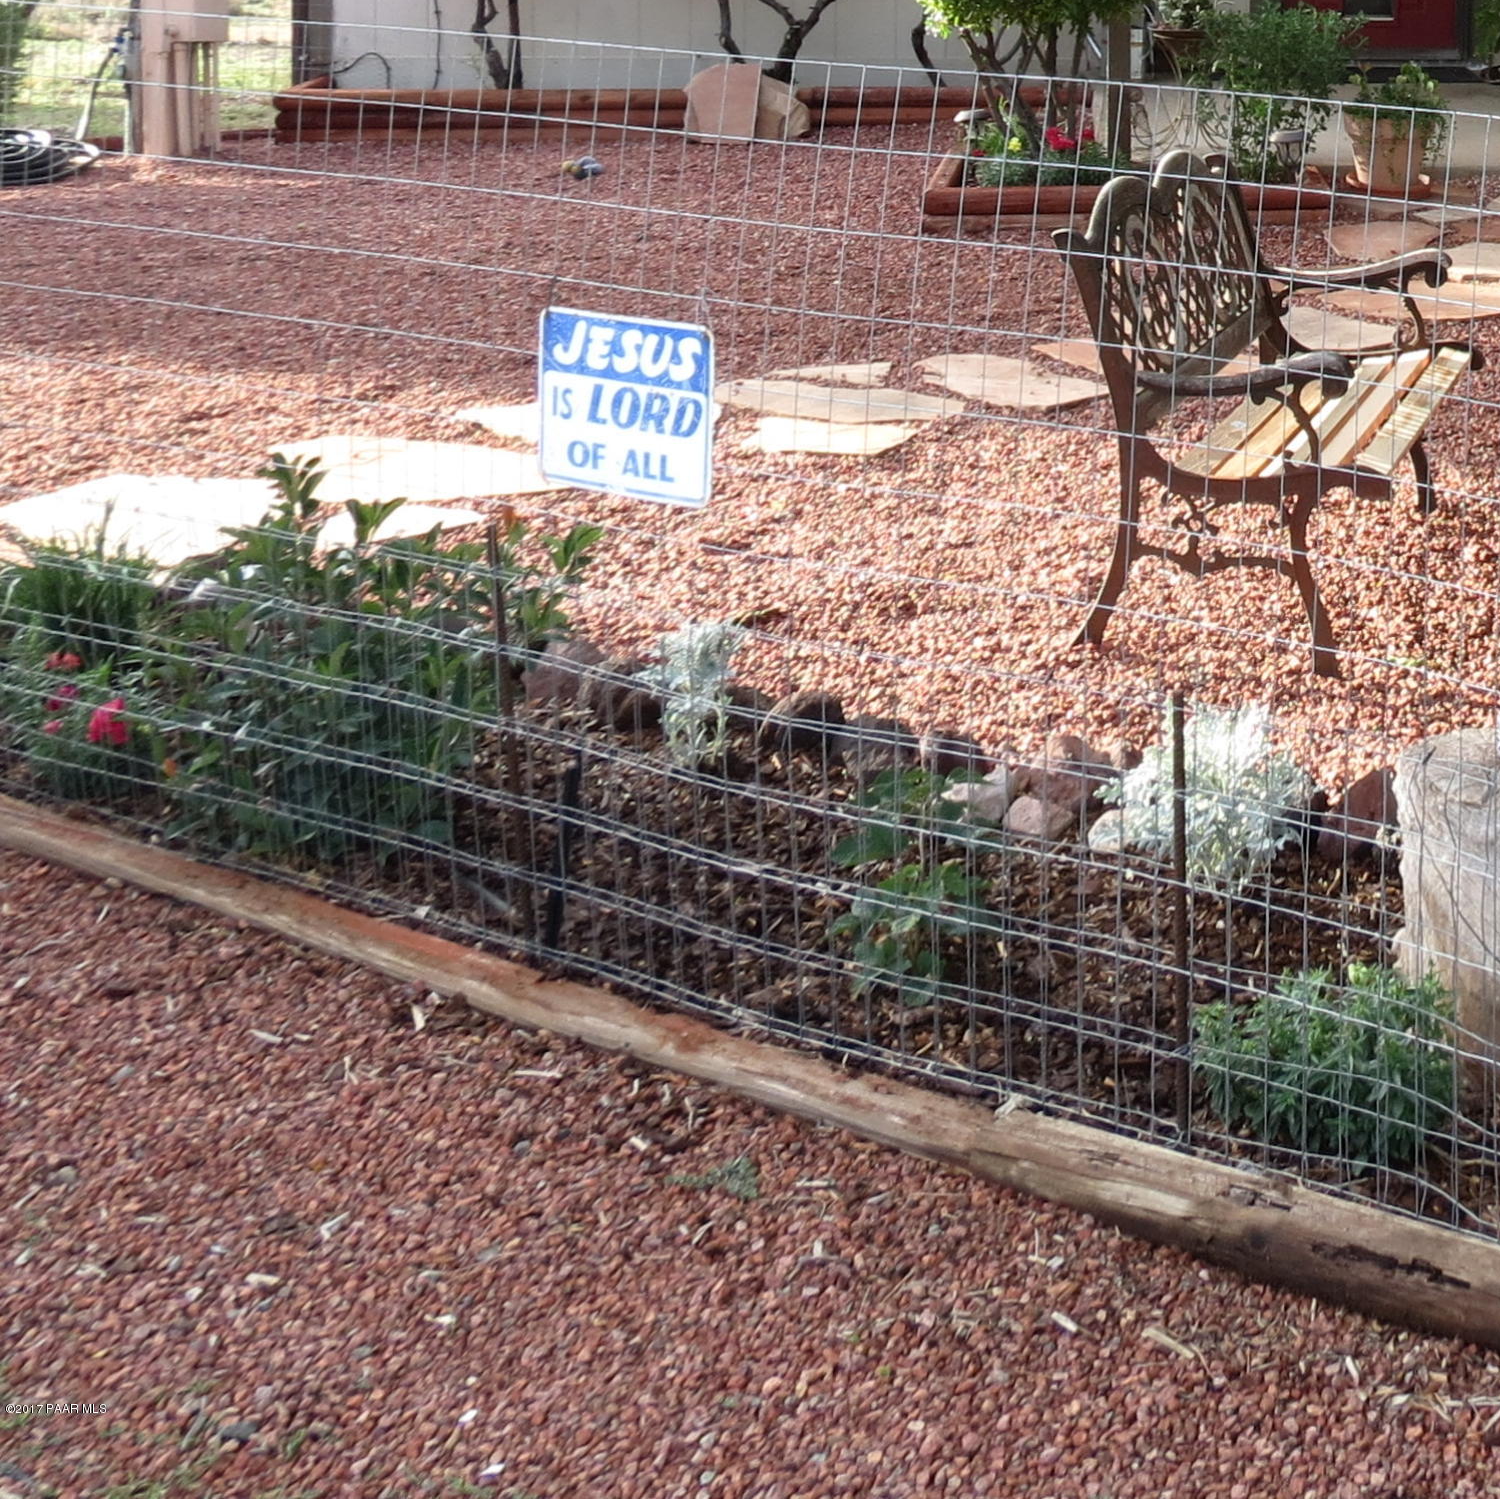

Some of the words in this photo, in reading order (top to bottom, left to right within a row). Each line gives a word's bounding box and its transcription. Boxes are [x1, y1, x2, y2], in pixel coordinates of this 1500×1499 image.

[552, 320, 702, 382] JESUS
[552, 386, 573, 420] IS
[587, 384, 703, 438] LORD
[567, 440, 606, 470] OF
[622, 449, 675, 482] ALL
